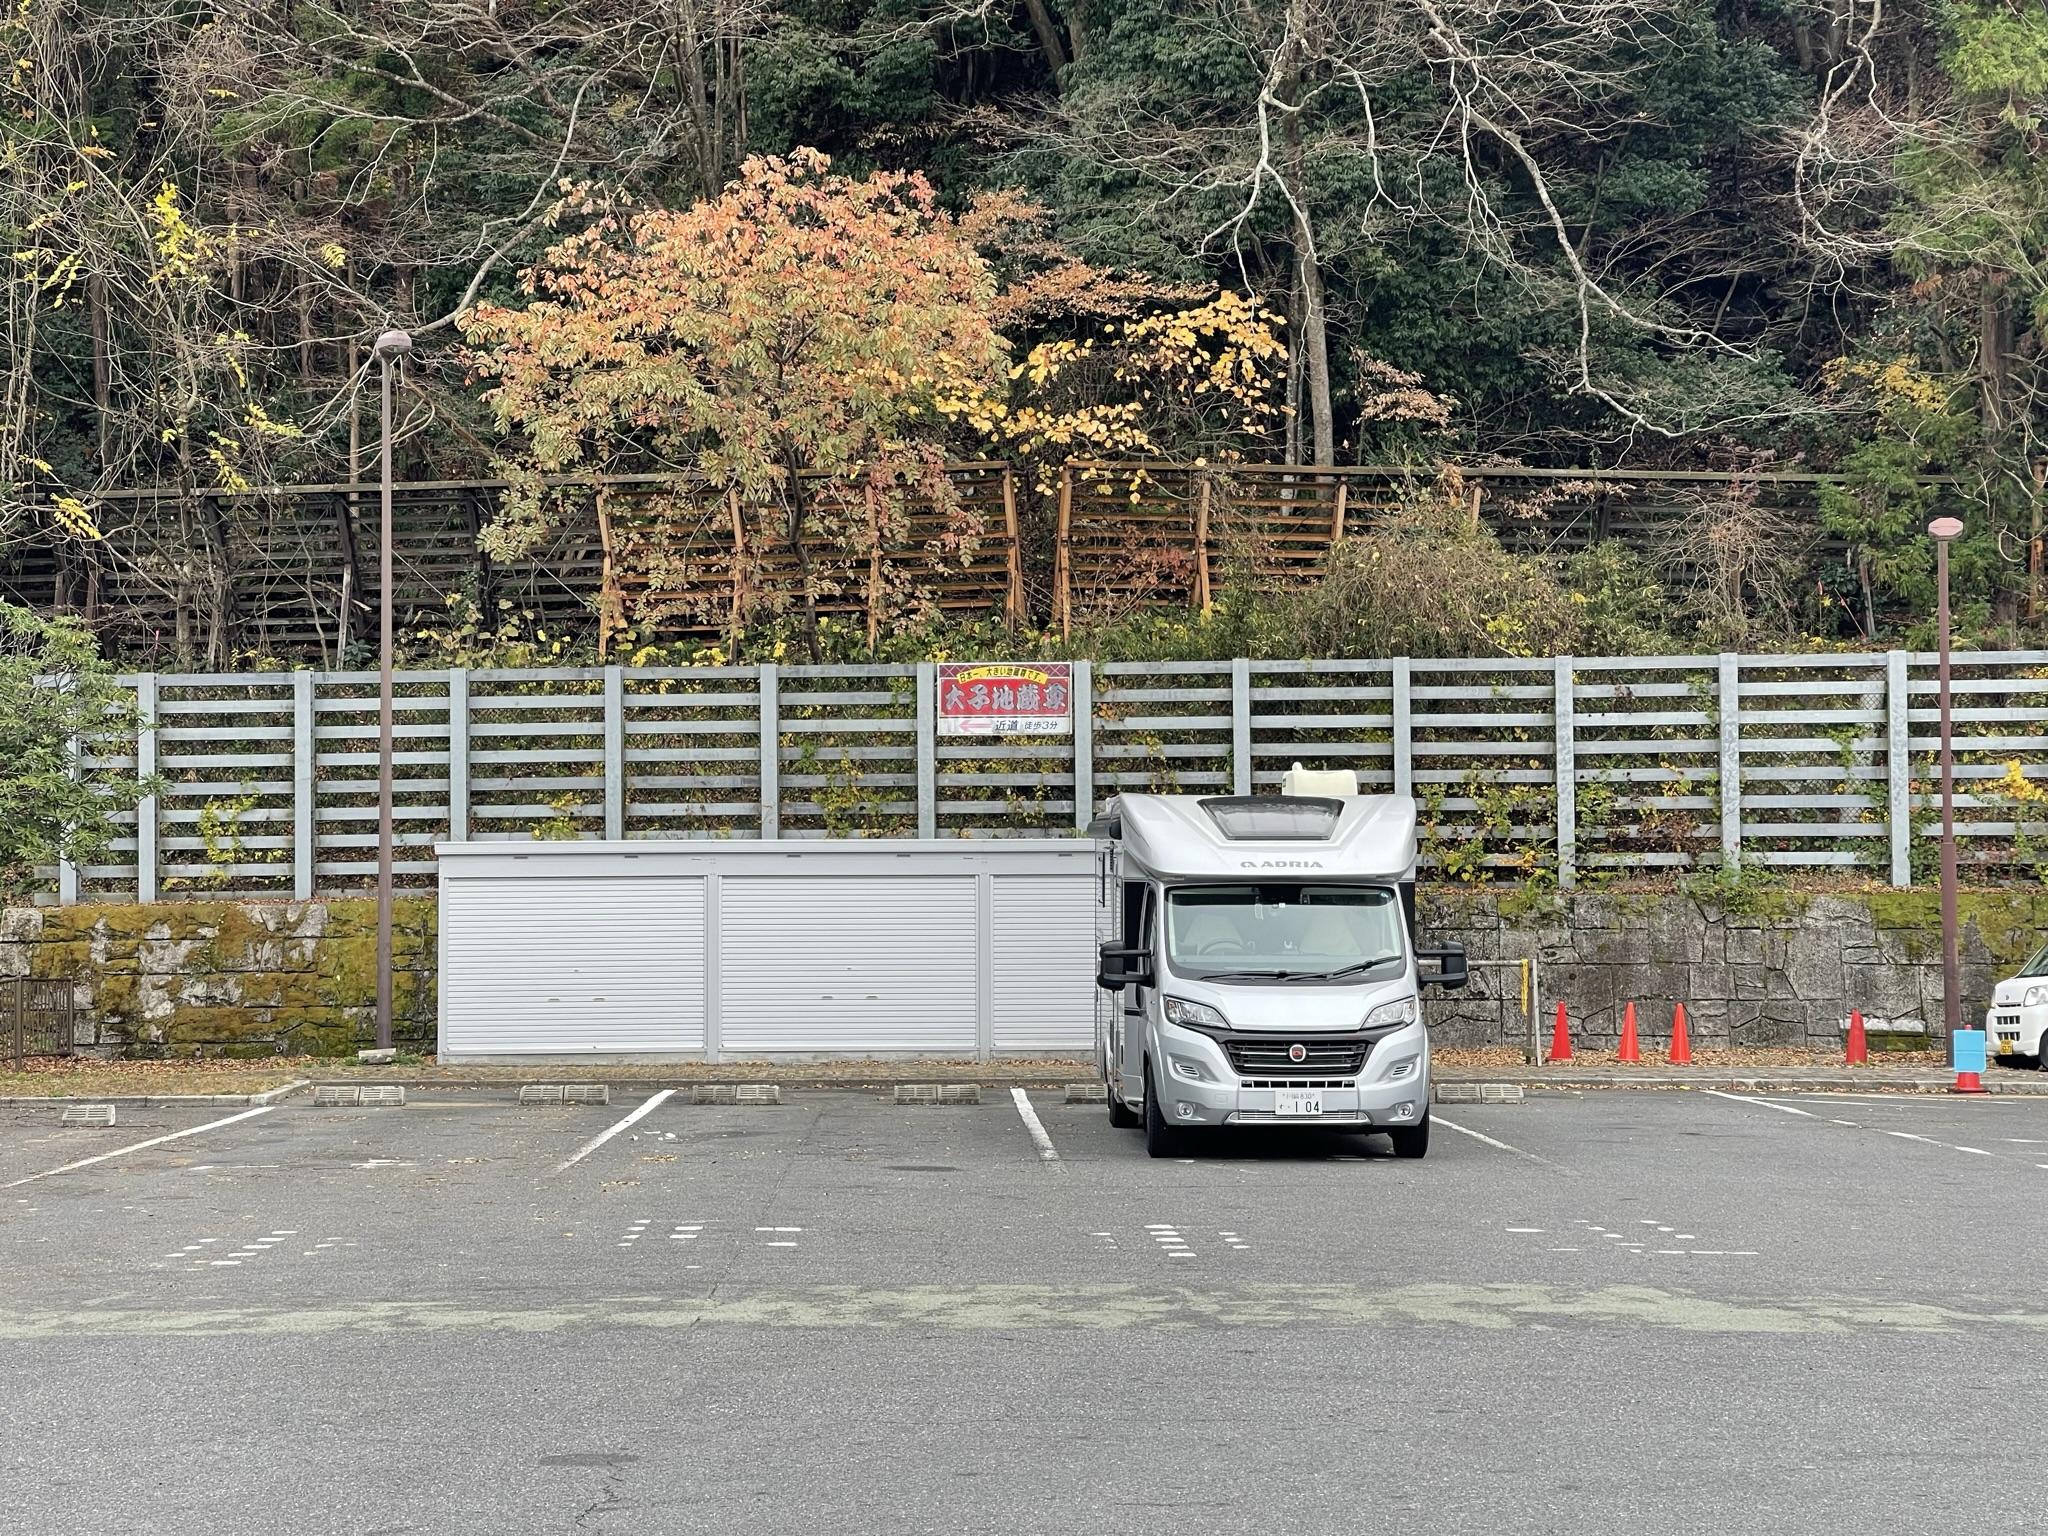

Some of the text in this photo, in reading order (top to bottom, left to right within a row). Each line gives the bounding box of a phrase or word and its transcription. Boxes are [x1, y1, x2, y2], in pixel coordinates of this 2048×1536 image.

[995, 720, 1059, 732] 近道 徒歩3分
[1260, 860, 1324, 869] ADRIA
